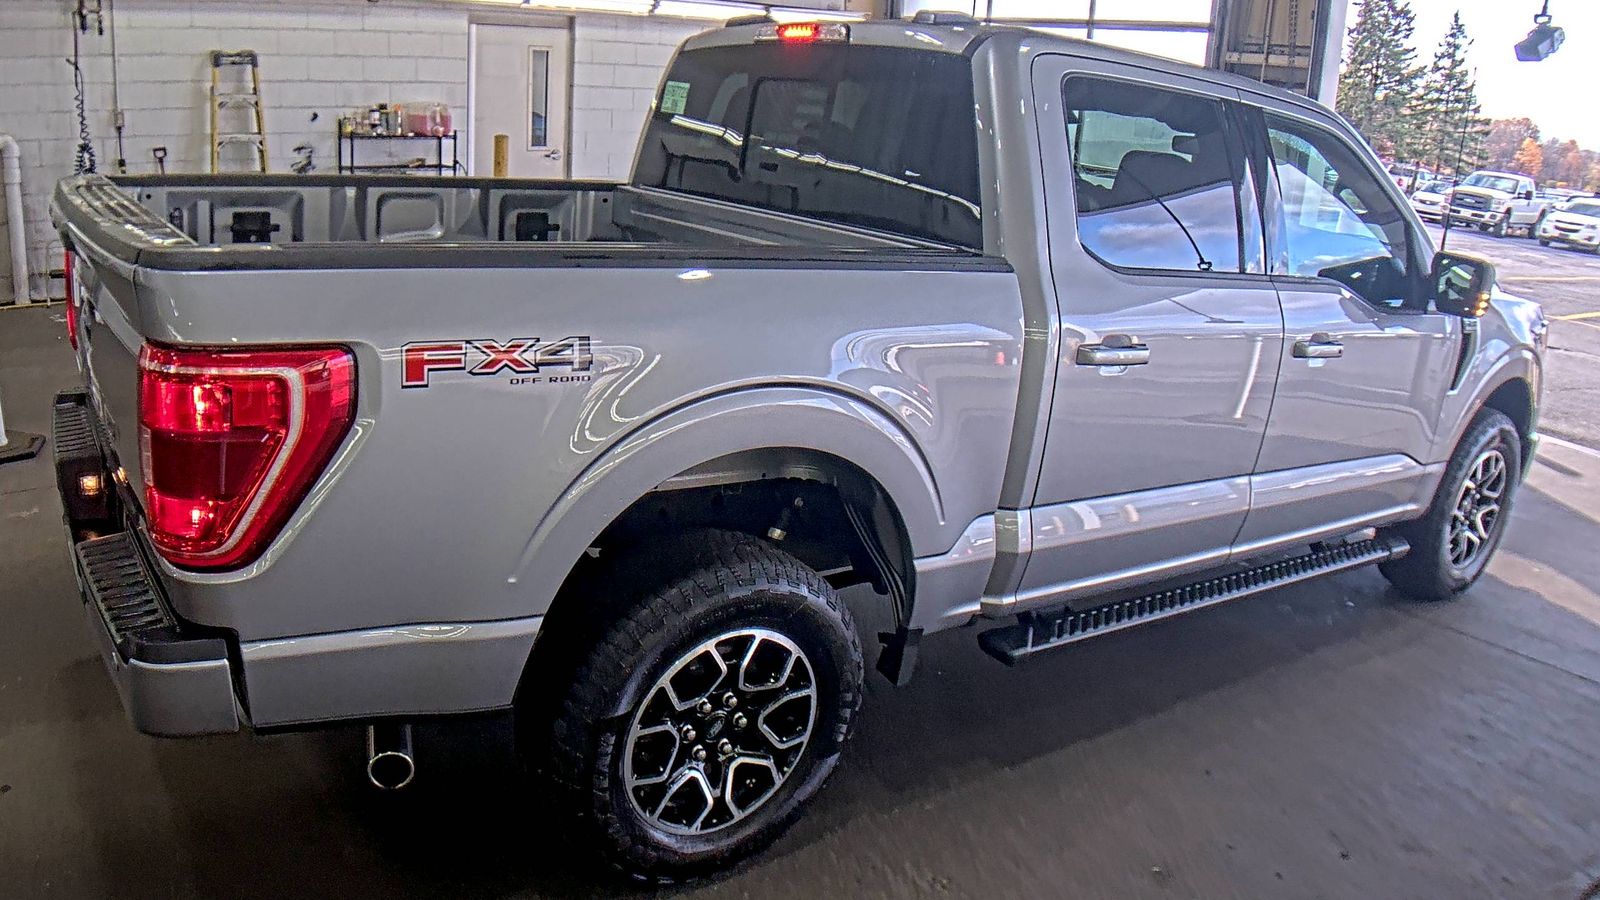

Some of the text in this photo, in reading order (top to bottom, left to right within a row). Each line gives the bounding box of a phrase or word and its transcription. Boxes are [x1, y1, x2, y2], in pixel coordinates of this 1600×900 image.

[401, 336, 593, 389] FX4
[510, 375, 591, 385] OFF ROAD
